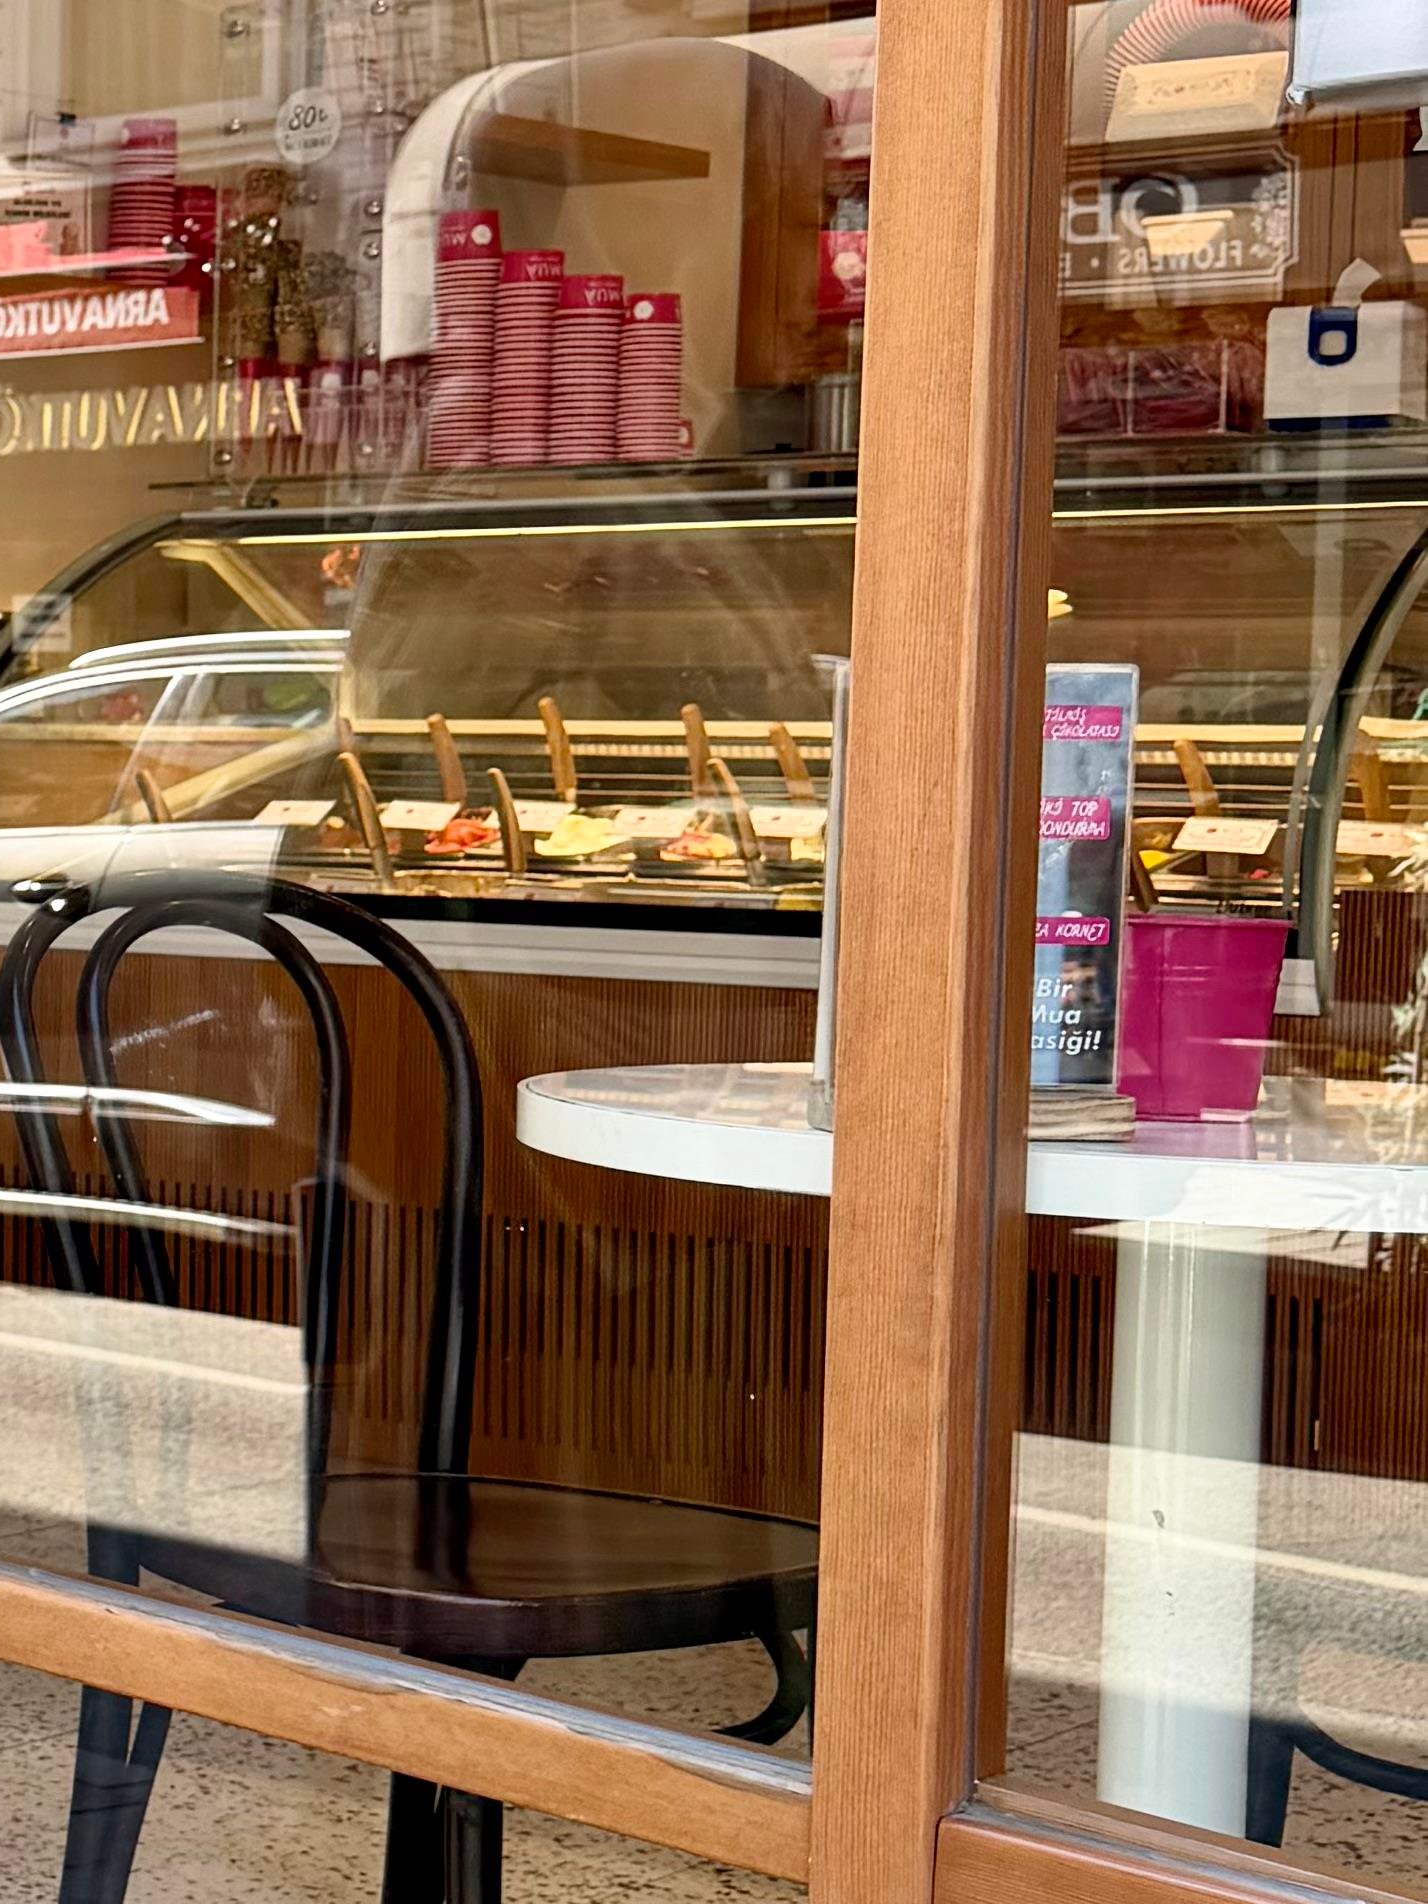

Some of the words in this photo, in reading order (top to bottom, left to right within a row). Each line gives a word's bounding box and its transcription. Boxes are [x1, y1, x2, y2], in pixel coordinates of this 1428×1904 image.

[1072, 800, 1099, 816] TOP
[1055, 923, 1106, 941] KORNET
[1037, 978, 1073, 999] Bir
[1031, 1030, 1102, 1056] asiği!
